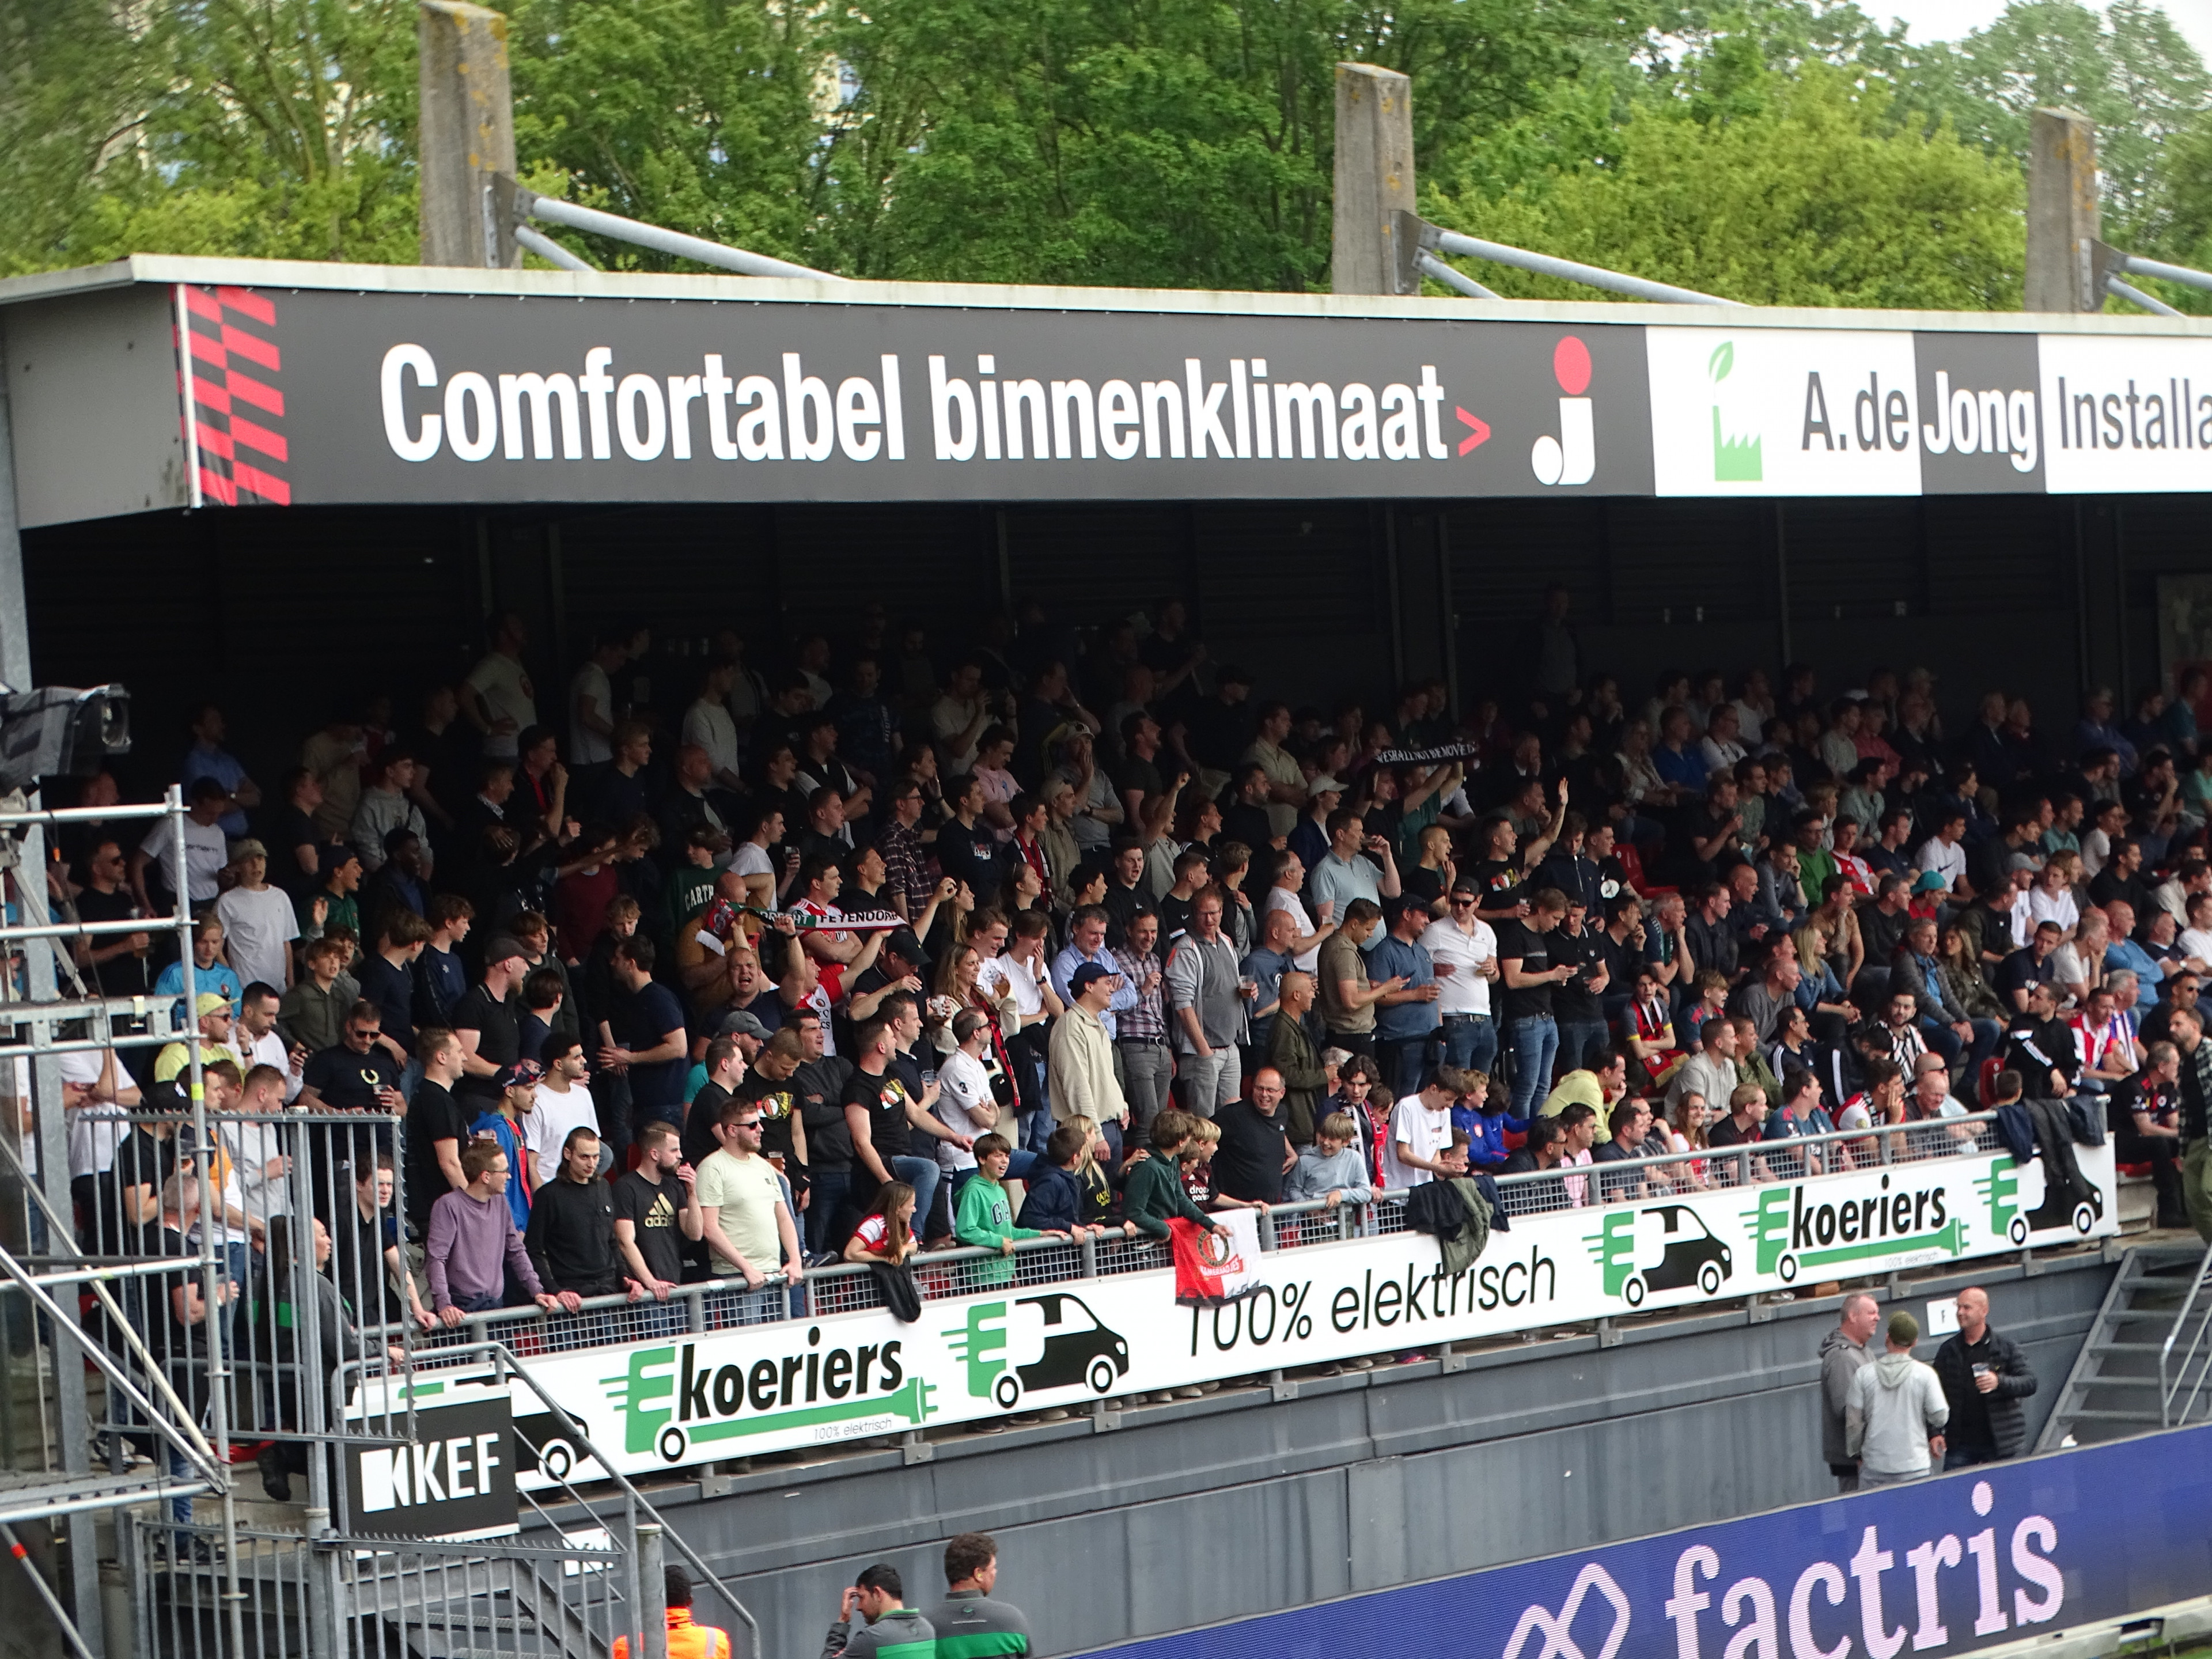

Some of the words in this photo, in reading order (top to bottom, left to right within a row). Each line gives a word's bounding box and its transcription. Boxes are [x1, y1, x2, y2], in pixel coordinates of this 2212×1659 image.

[380, 343, 906, 461] Comfortabel
[928, 354, 1448, 460] binnenklimaat
[1922, 370, 2037, 473] Jong
[959, 1081, 968, 1093] 3
[1191, 1280, 1313, 1357] 100%
[1331, 1244, 1556, 1334] elektrisch
[814, 1425, 840, 1440] 100%
[843, 1416, 892, 1435] elektrisch
[1665, 1480, 2065, 1659] factris
